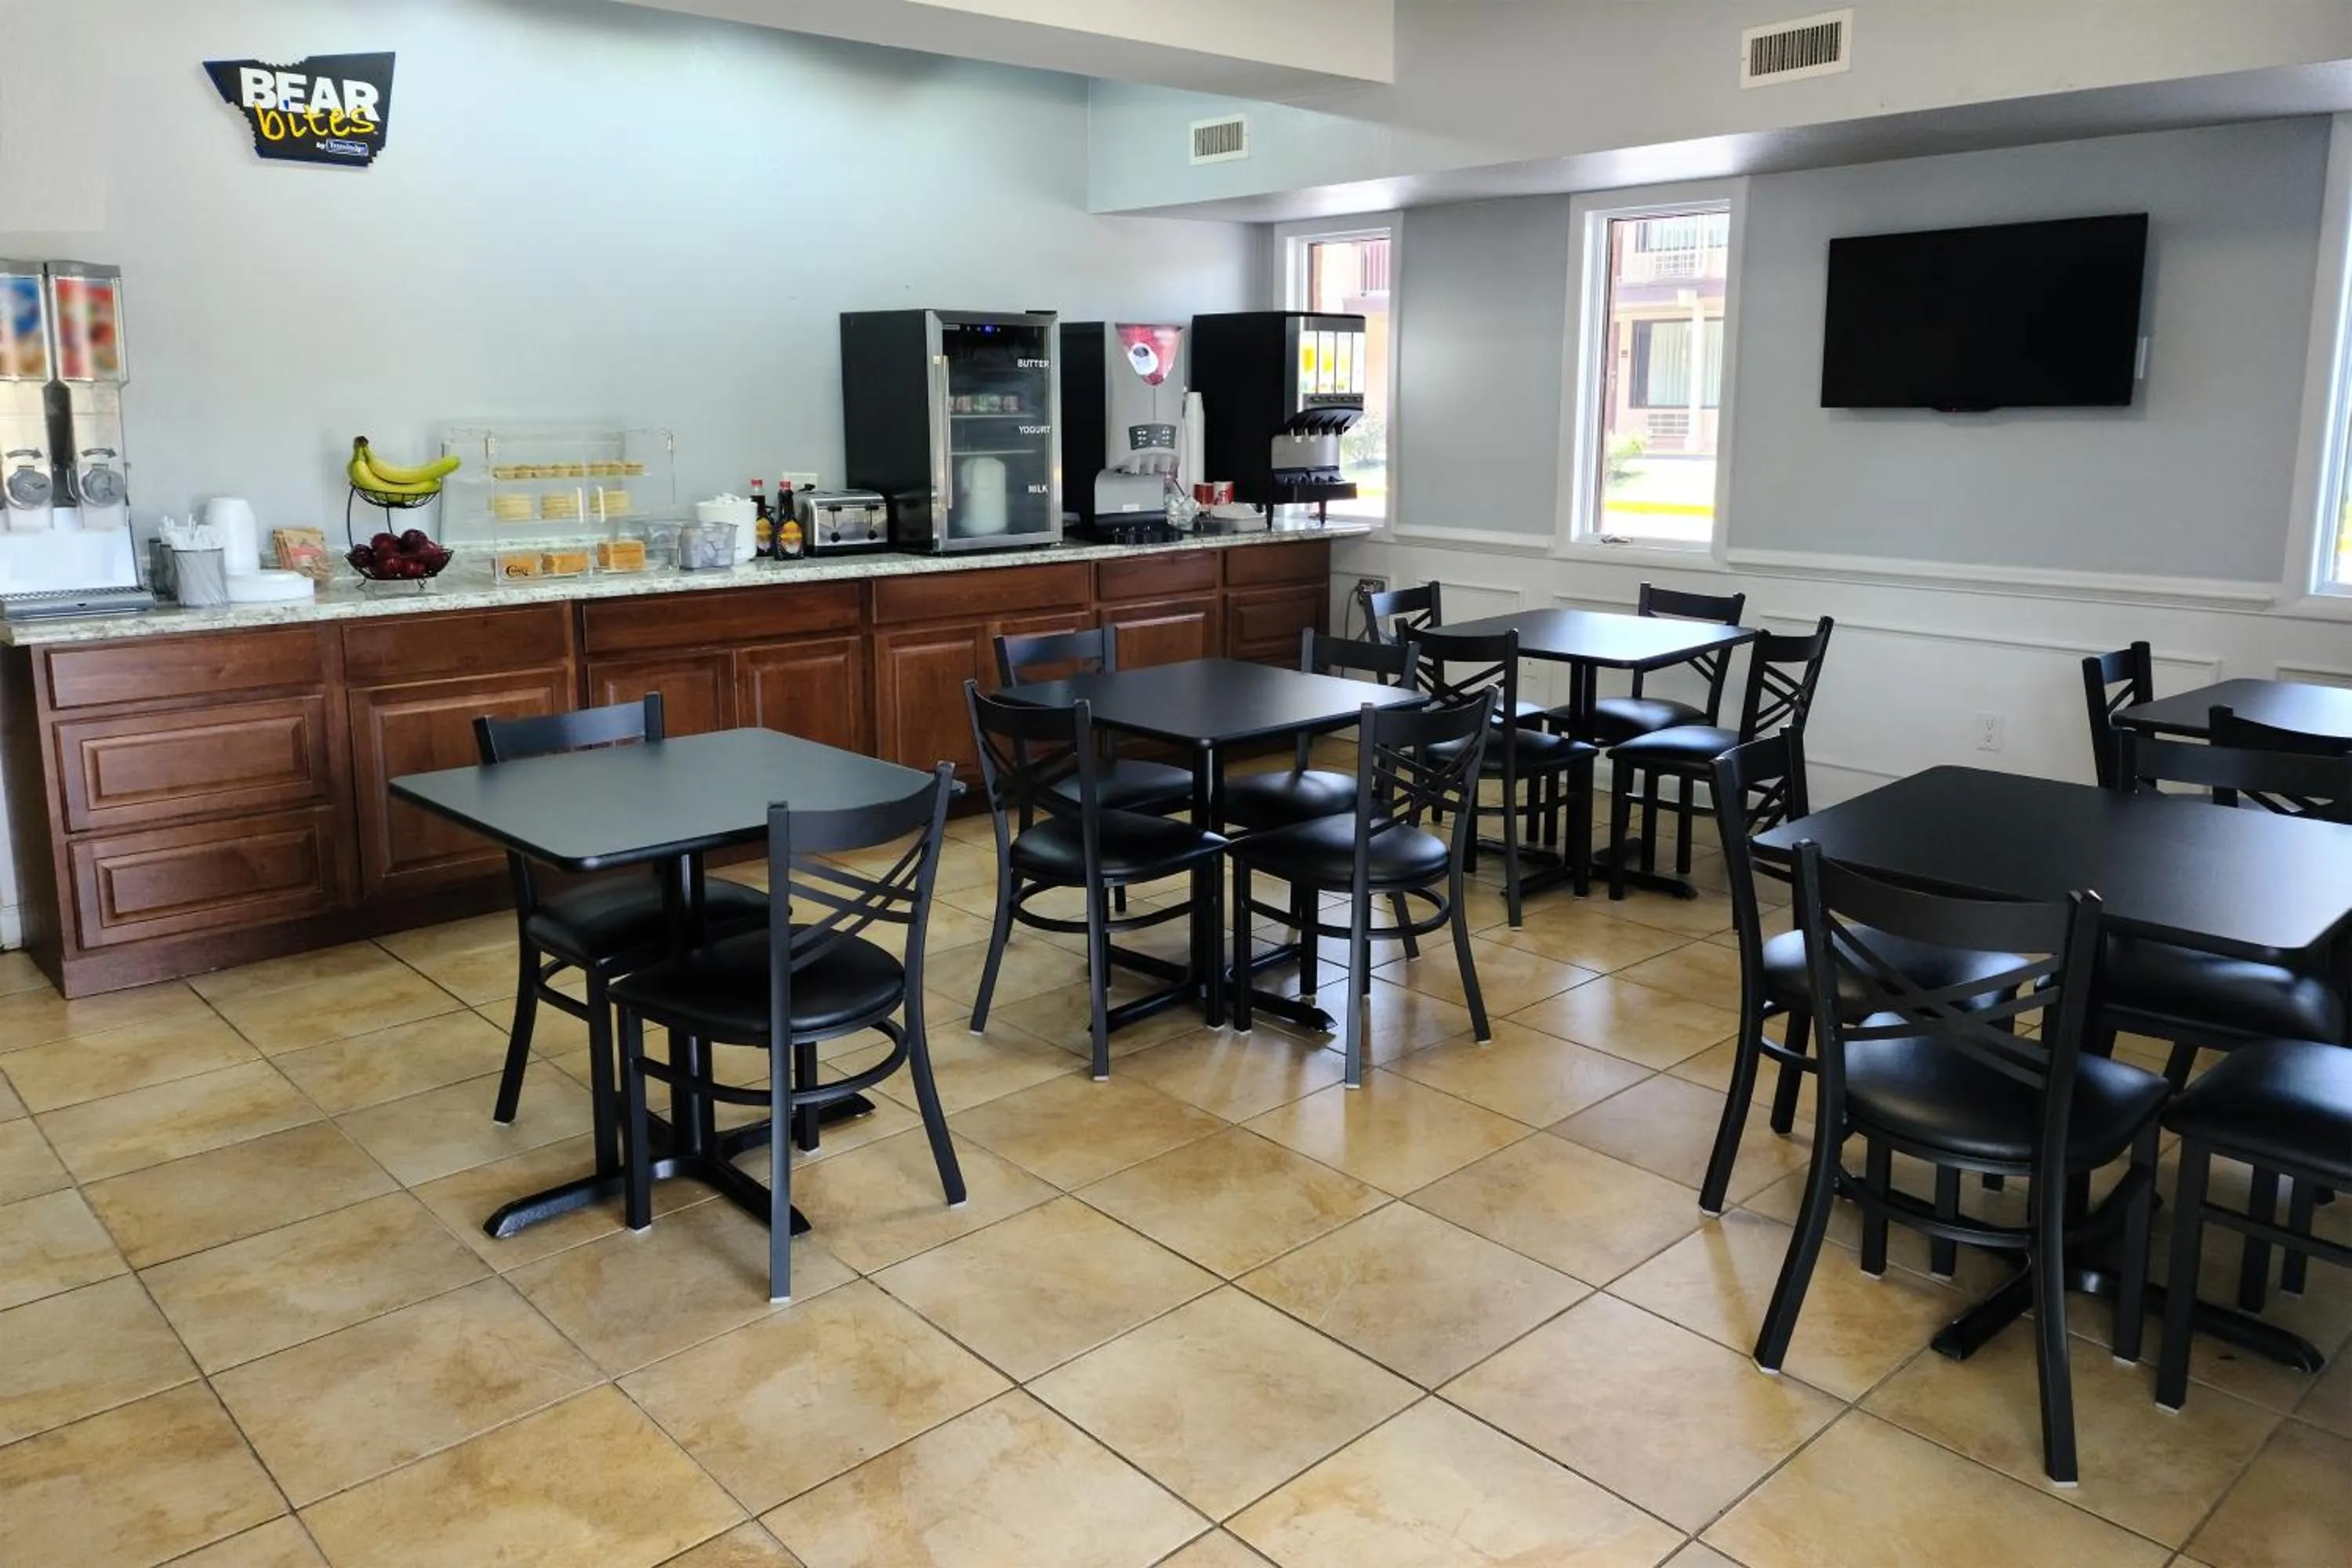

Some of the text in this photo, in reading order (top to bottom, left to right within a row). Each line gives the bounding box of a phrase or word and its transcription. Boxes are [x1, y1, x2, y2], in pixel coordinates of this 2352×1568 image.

[239, 67, 380, 122] BEAR
[252, 100, 376, 141] bites
[1017, 358, 1050, 368] BUTTER
[1018, 426, 1051, 435] YOGURT
[1028, 485, 1048, 493] MILK
